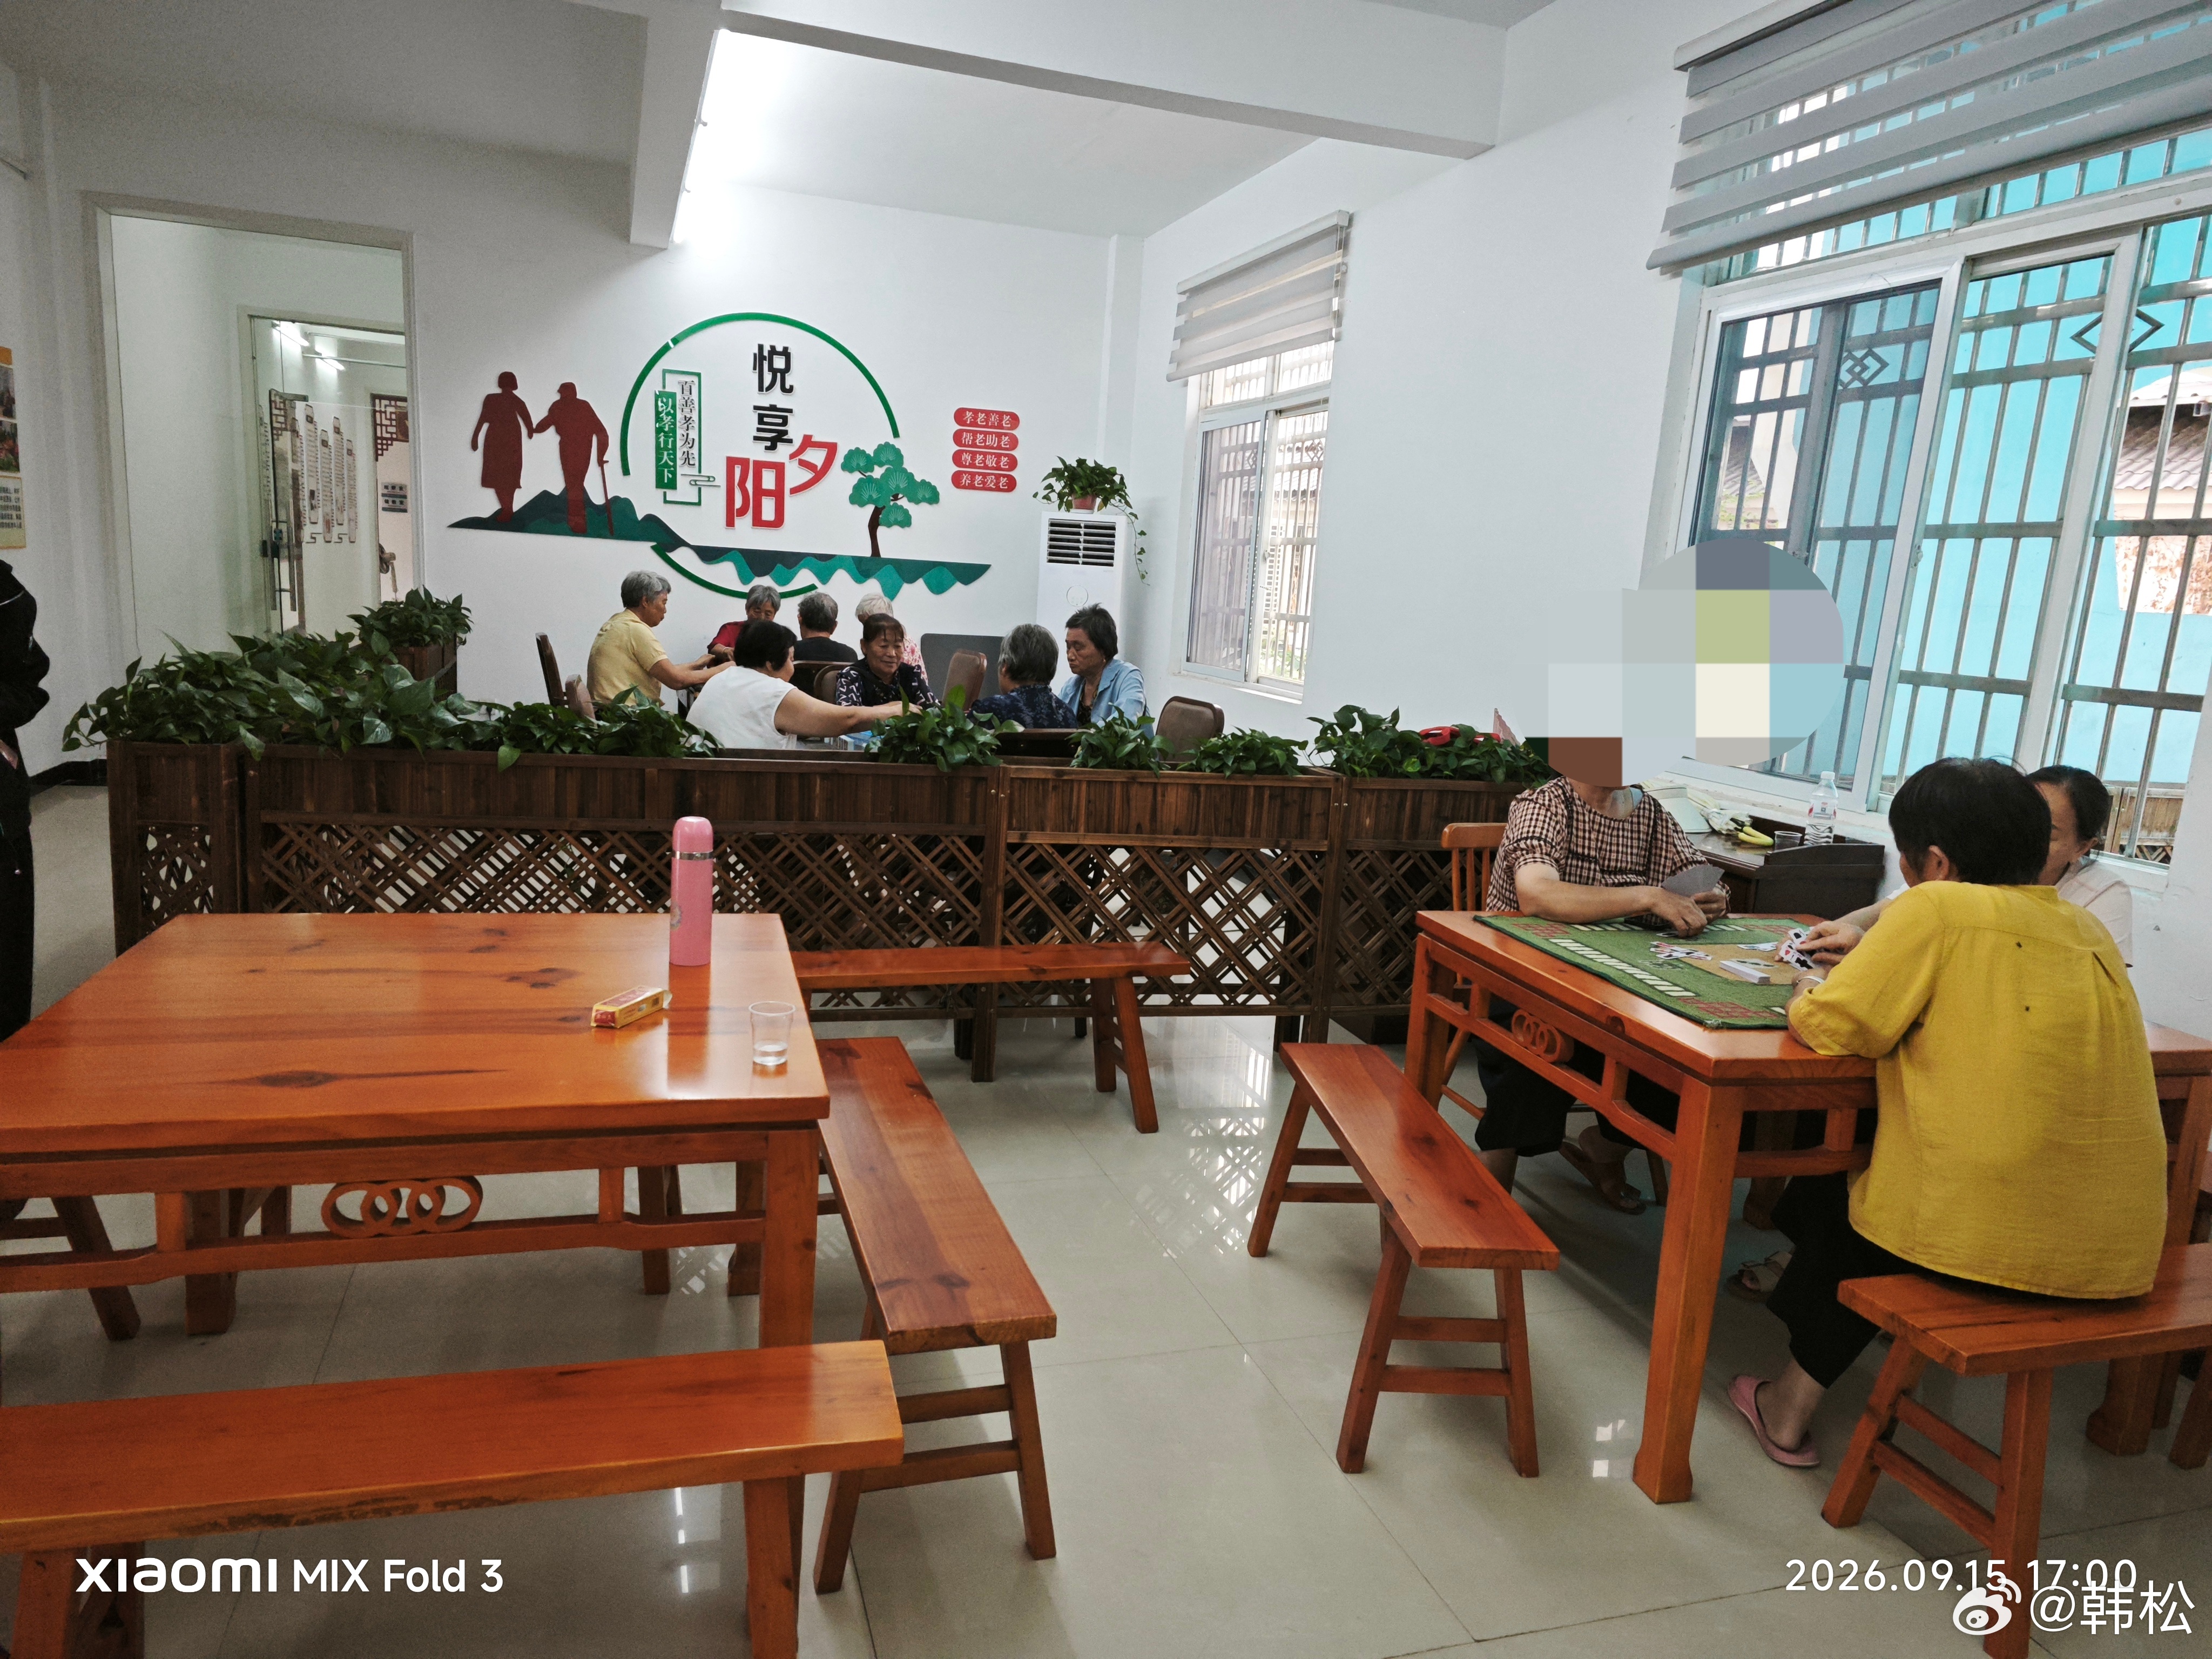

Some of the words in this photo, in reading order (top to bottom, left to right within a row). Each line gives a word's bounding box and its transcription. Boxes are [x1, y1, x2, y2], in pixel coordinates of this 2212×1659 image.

[752, 342, 794, 451] 悦享
[678, 380, 696, 468] 百善孝为先
[962, 410, 1011, 427] 孝老善老
[658, 397, 675, 483] 以孝行天下
[961, 431, 1010, 448] 帮老助老
[961, 452, 1010, 468] 尊老敬老
[960, 473, 1009, 489] 养老爱老
